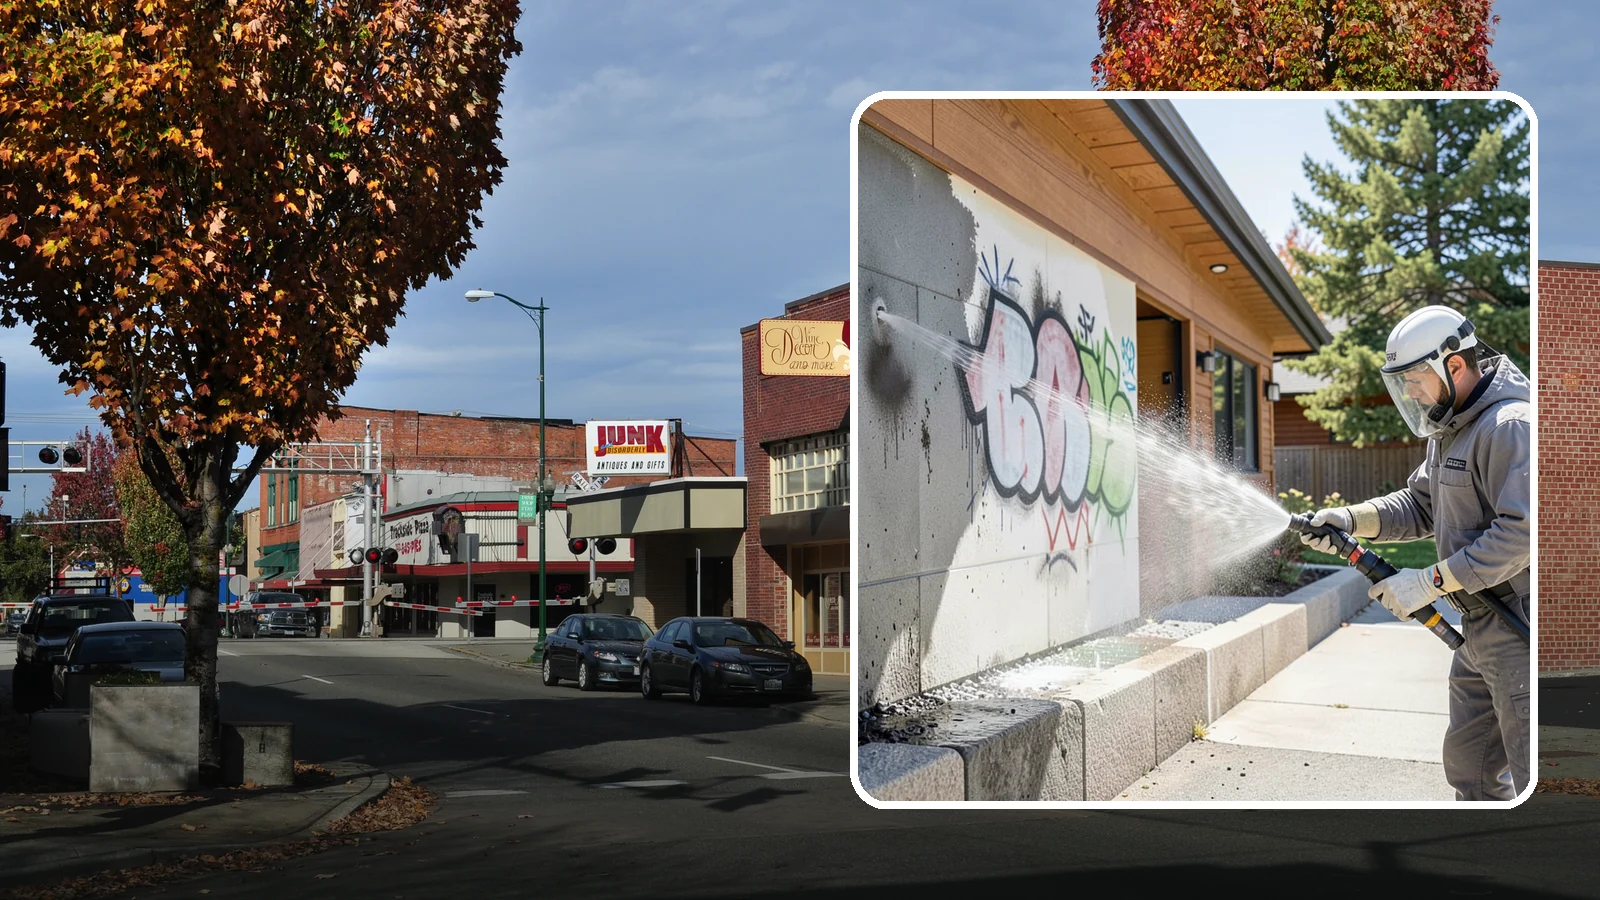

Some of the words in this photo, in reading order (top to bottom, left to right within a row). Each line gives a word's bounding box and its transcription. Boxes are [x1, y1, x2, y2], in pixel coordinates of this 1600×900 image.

[765, 328, 831, 365] Decor
[595, 425, 665, 457] JUNK
[607, 446, 646, 454] DISORDERLY
[597, 461, 628, 470] ANTIQUES
[631, 461, 644, 470] AND
[647, 460, 665, 469] GIFTS
[590, 476, 608, 491] SING
